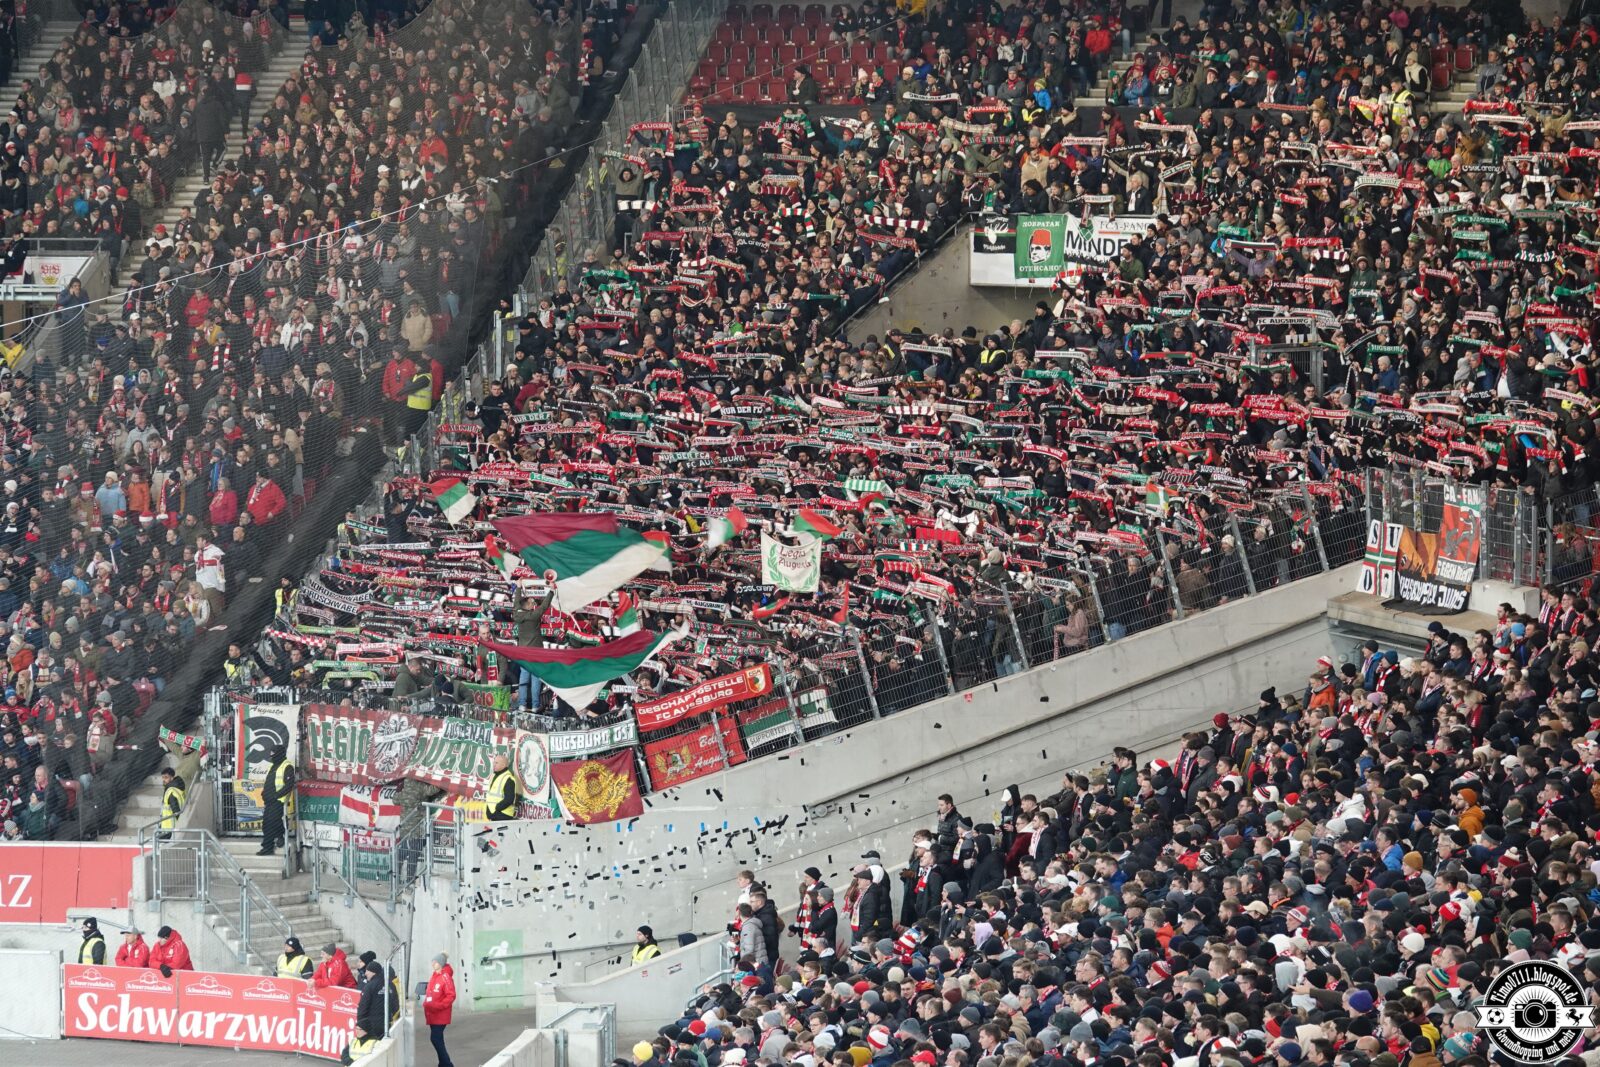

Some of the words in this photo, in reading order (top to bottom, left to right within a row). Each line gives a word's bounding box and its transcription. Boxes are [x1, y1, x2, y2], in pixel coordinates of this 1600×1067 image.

[720, 406, 736, 415] NUR
[700, 454, 746, 466] AUSBURG
[656, 710, 671, 720] FC
[613, 724, 636, 743] OST
[308, 718, 373, 765] LEGIO
